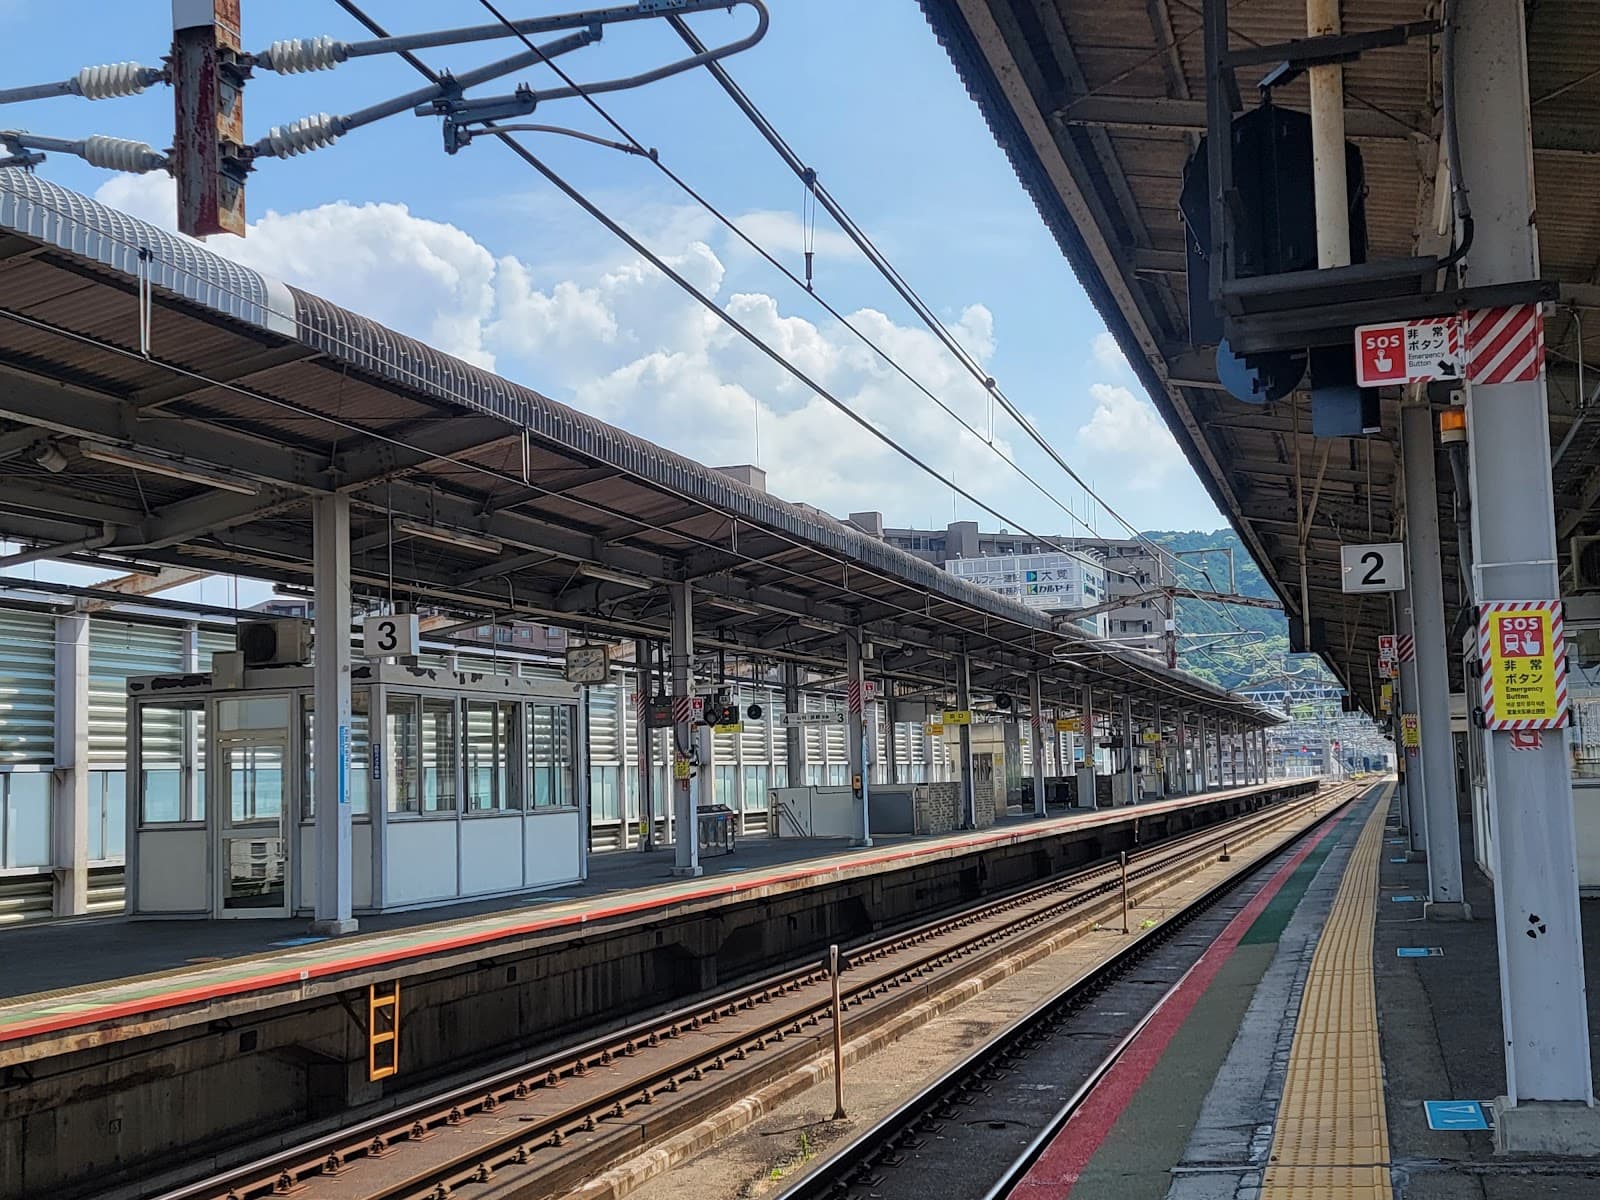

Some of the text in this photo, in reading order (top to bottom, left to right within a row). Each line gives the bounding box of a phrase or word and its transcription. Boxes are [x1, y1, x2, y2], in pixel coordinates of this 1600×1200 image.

[1366, 335, 1400, 349] SOS
[1408, 340, 1444, 351] ボタン
[1408, 352, 1445, 360] Emergency
[1361, 551, 1386, 585] 2
[1503, 618, 1538, 630] SOS
[378, 621, 397, 651] 3
[1504, 659, 1542, 671] 非常
[1505, 673, 1543, 684] ボタン
[783, 715, 789, 725] 4
[837, 713, 844, 723] 3
